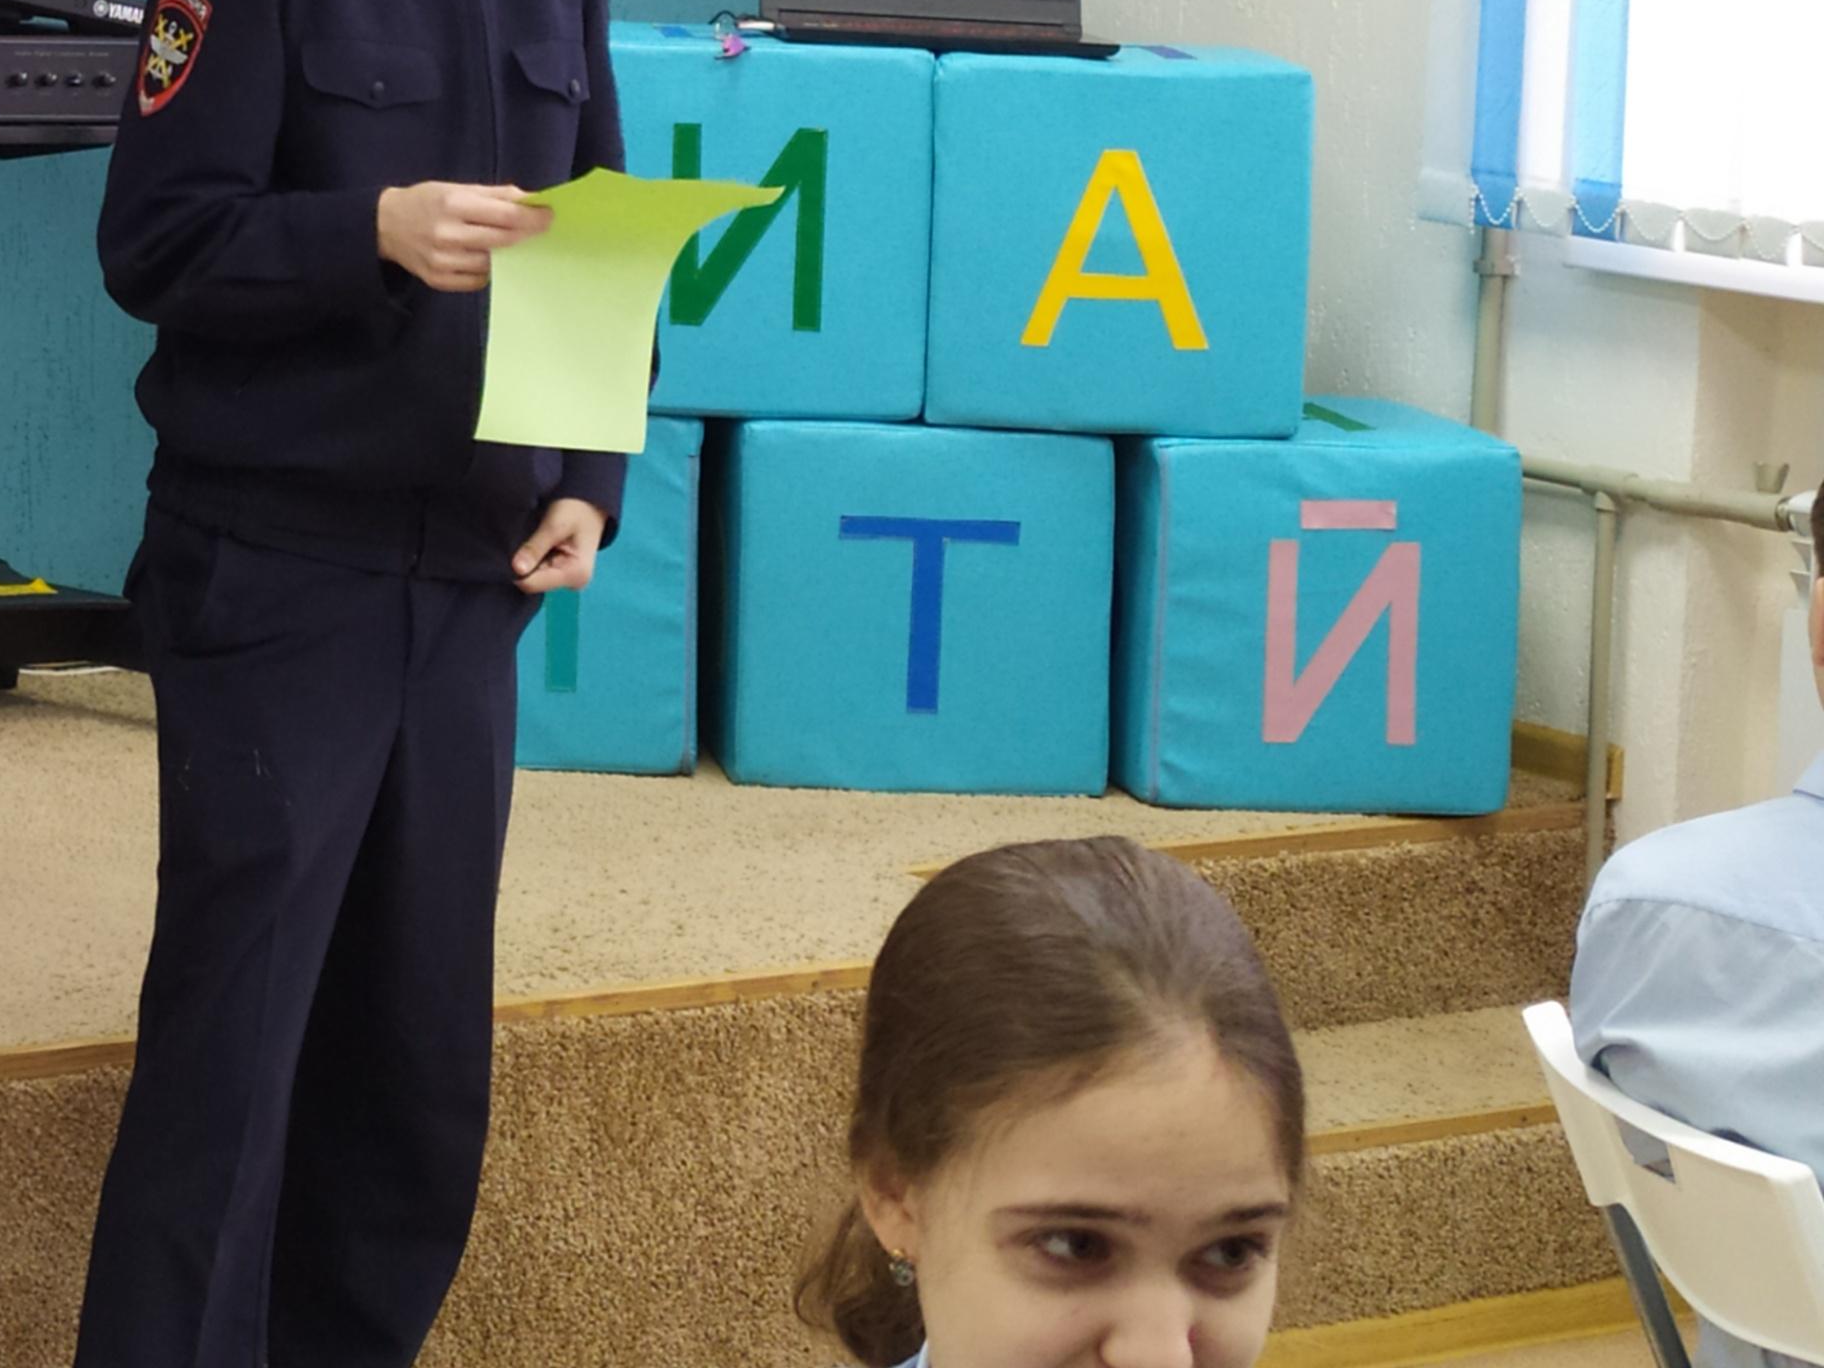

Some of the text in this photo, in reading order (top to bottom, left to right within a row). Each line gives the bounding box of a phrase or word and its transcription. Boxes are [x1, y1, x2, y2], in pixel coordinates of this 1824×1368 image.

[108, 2, 144, 24] YAMA
[1020, 149, 1210, 351] А
[839, 514, 1022, 715] Т
[1262, 499, 1422, 746] Й
